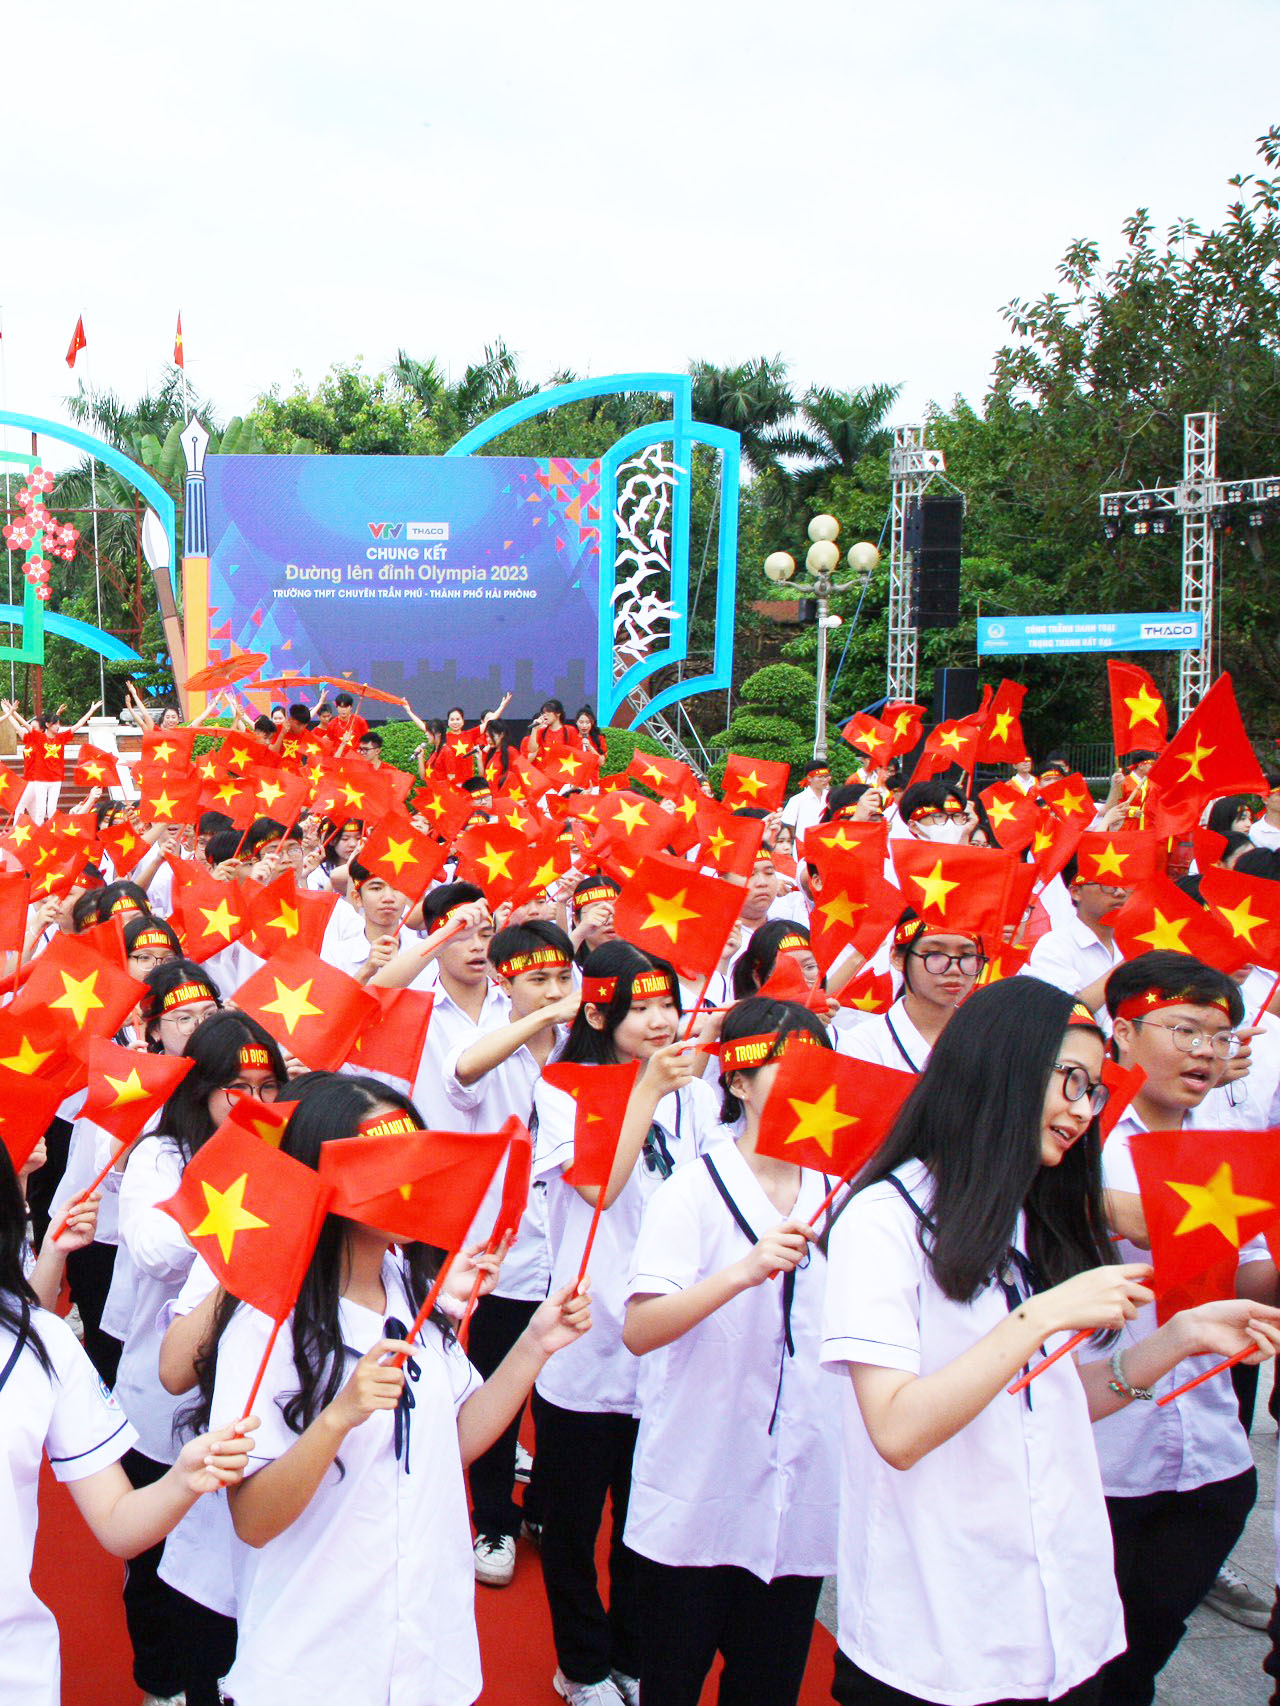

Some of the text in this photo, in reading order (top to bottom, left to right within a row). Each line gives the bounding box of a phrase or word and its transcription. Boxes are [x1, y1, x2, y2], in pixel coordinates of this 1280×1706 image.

[368, 522, 403, 539] VTV
[366, 543, 447, 560] CHUNG KẾT
[285, 564, 528, 584] Đường lên đỉnh Olympia 2023
[273, 587, 311, 598] TRƯỜNG
[314, 588, 336, 598] THPT
[338, 586, 375, 598] CHUYÊN
[378, 586, 402, 597] TRẦN
[404, 587, 422, 598] PHÚ
[430, 587, 460, 598] THÀNH
[463, 586, 482, 598] PHỐ
[485, 586, 501, 598] HẢI
[504, 587, 537, 598] PHÒNG
[1144, 626, 1192, 635] THACO
[641, 975, 666, 992] THÀNH
[175, 985, 200, 1002] THÀNH
[735, 1042, 768, 1063] TRỌNG
